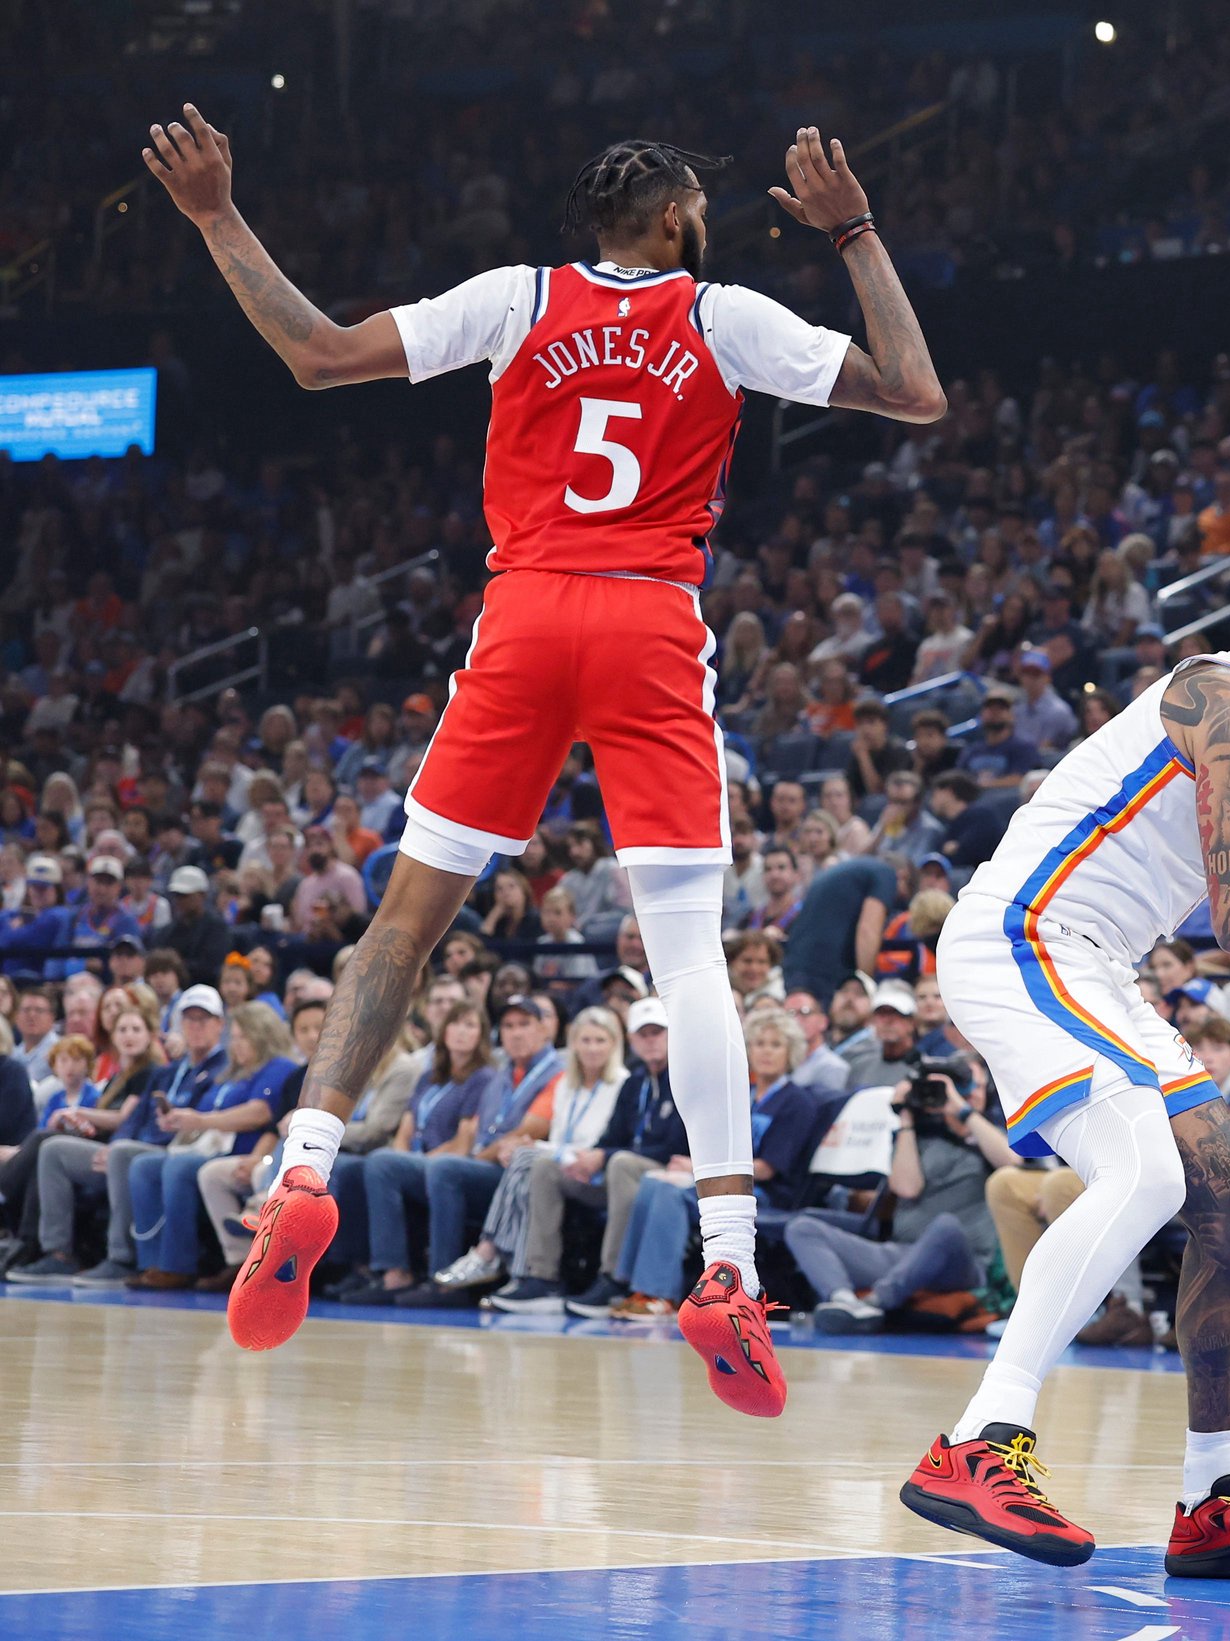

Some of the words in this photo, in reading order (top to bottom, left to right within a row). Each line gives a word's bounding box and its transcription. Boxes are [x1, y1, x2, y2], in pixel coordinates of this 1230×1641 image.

[613, 267, 637, 277] NIKE
[533, 326, 650, 389] JONES
[647, 340, 699, 401] JR.
[564, 396, 643, 514] 5
